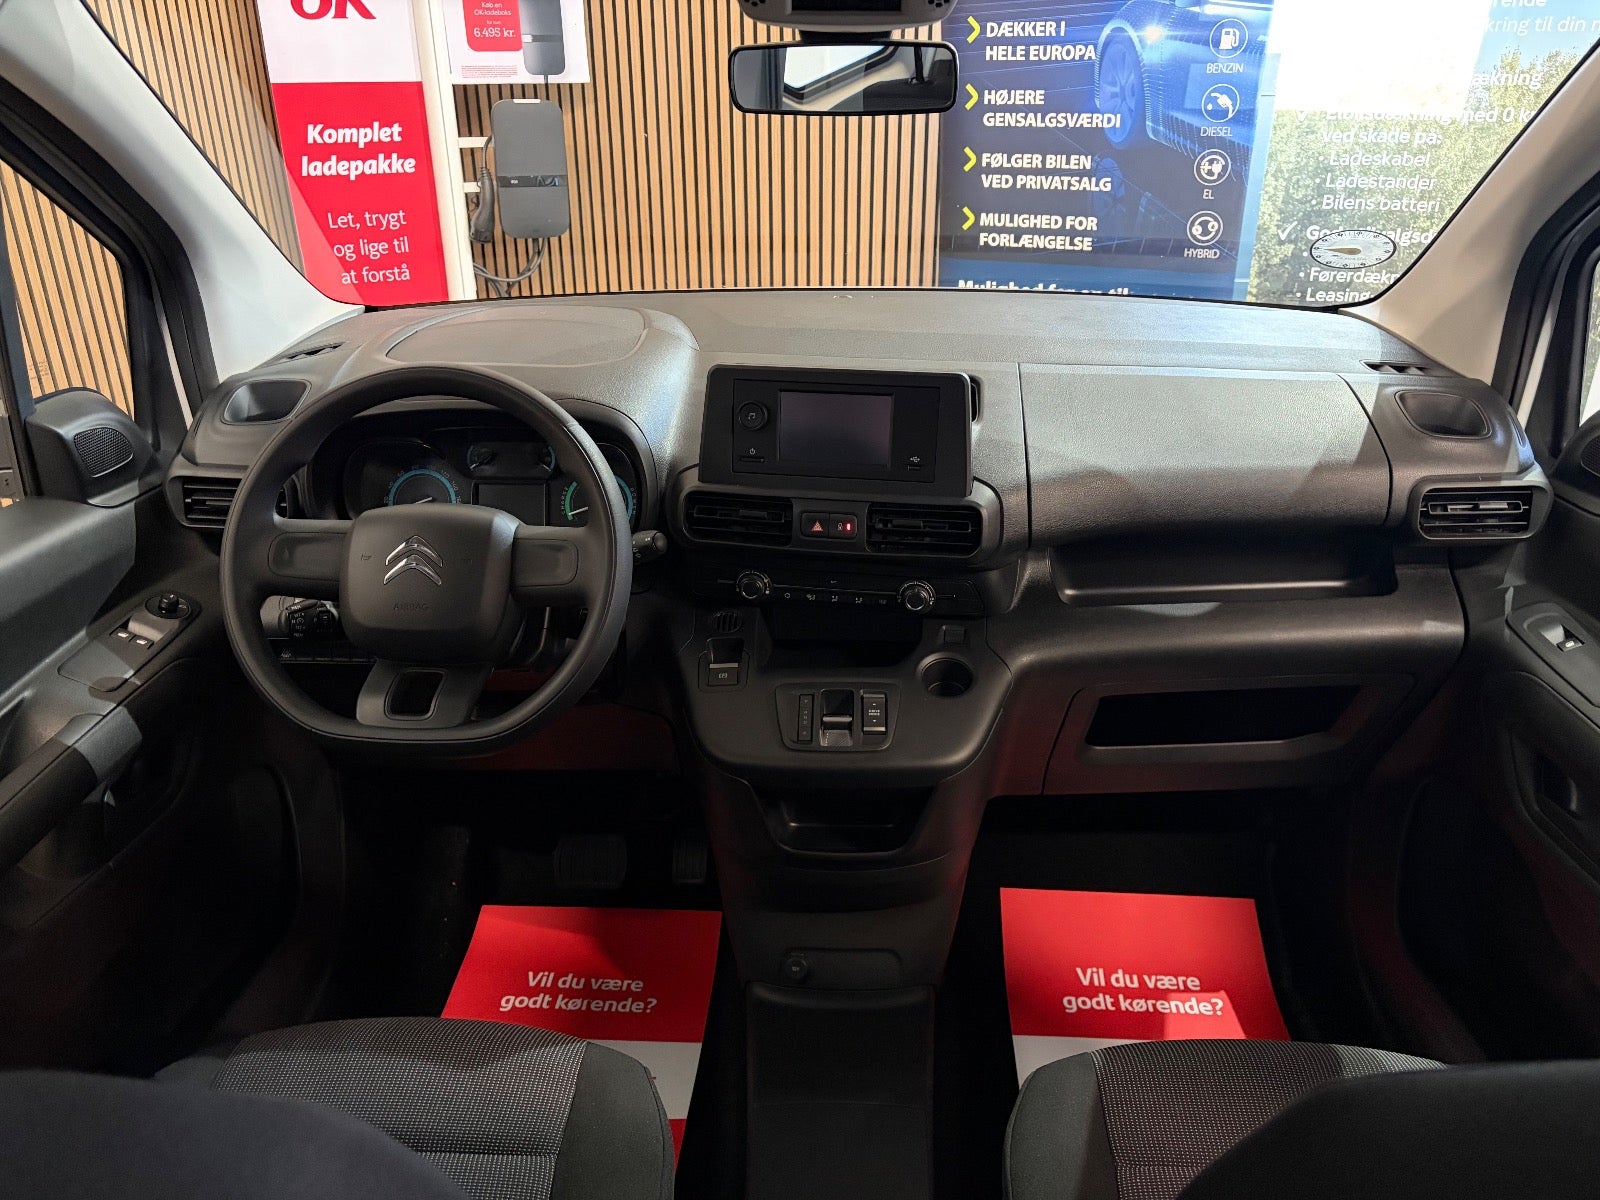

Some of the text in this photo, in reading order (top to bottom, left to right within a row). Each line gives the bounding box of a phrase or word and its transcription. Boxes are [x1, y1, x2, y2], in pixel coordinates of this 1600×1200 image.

[473, 27, 516, 37] 6.495 kr.
[986, 20, 1065, 38] DÆKKER I
[1535, 16, 1553, 32] til
[1558, 16, 1586, 32] din
[985, 45, 1097, 61] HELE EUROPA
[1206, 63, 1244, 74] BENZIN
[983, 89, 1045, 105] HØJERE
[982, 112, 1121, 129] GENSALGSVÆRDI
[1503, 107, 1516, 122] 0
[307, 121, 403, 149] Komplet
[1200, 126, 1233, 137] DIESEL
[1321, 128, 1442, 147] ved skade på:
[301, 152, 416, 181] ladepakke
[981, 152, 1092, 169] FØLGER BILEN
[1330, 150, 1431, 167] Ladeskabel
[981, 173, 1112, 192] VED PRIVATSALG
[1325, 175, 1437, 191] Ladestander
[1203, 189, 1214, 200] EL
[1321, 195, 1441, 213] Bilens batteri
[328, 208, 407, 231] Let, trygt
[980, 212, 1098, 231] MULIGHED FOR
[333, 236, 409, 260] og lige til
[979, 232, 1093, 251] FORLÆNGELSE
[1184, 247, 1220, 259] HYBRID
[341, 262, 410, 284] at forstå
[527, 971, 644, 992] Vil du være
[1075, 966, 1201, 991] Vil du være
[499, 993, 657, 1014] godt kørende?
[1062, 993, 1224, 1016] godt kørende?
